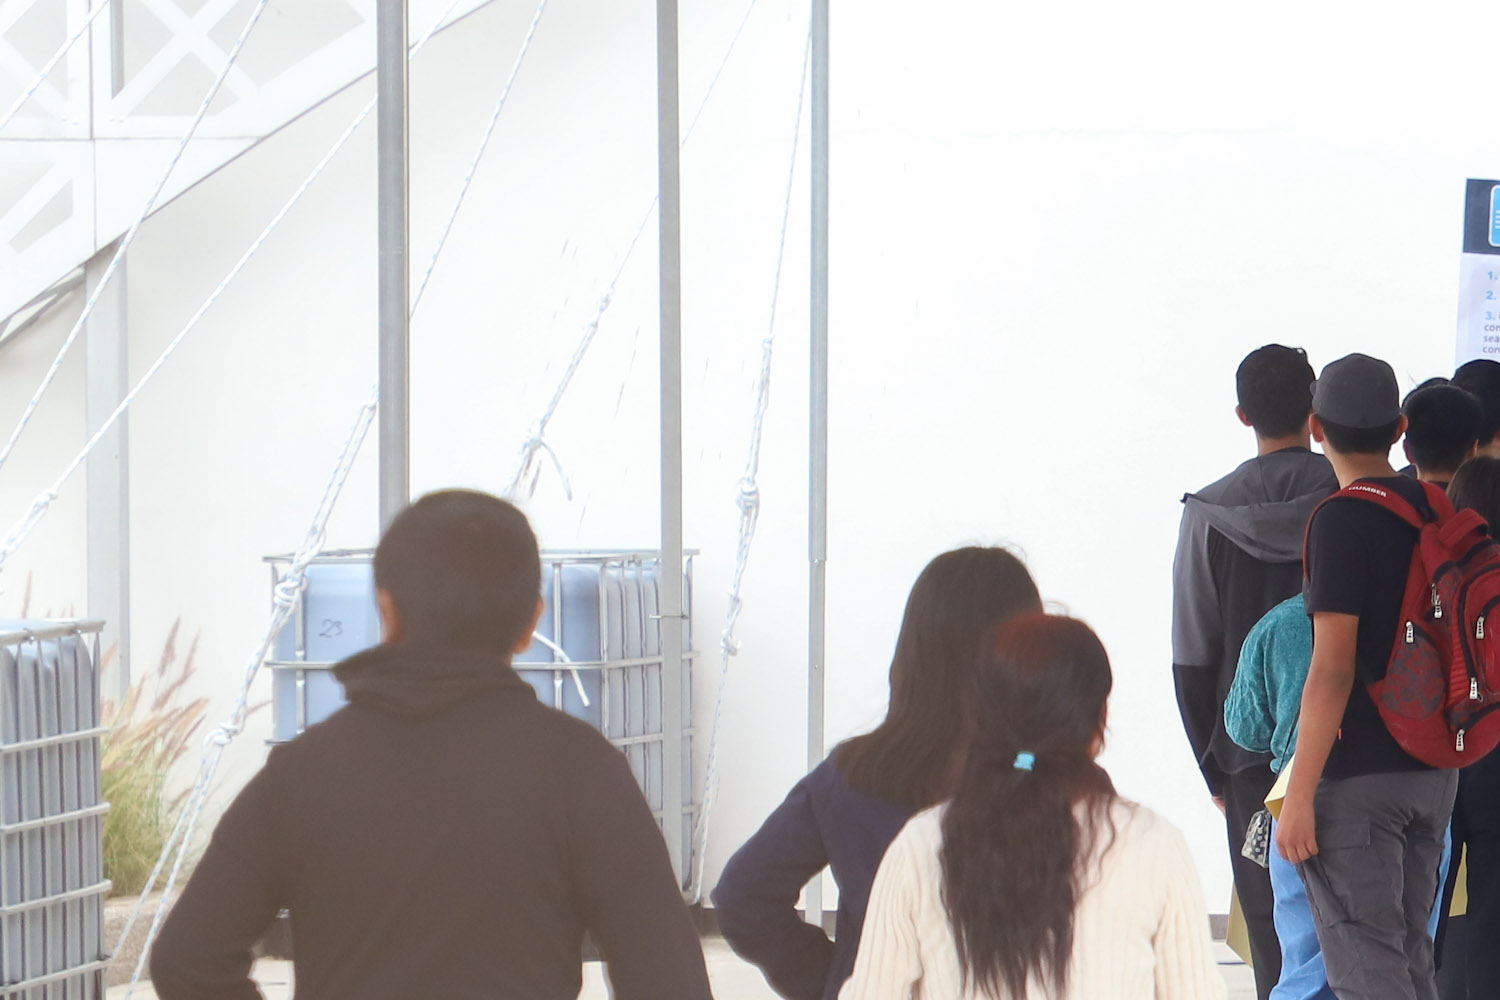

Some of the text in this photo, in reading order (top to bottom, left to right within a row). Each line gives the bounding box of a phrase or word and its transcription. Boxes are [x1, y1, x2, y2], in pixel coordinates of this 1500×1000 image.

[1488, 271, 1498, 280] 1.
[1485, 290, 1497, 300] 2.
[1485, 311, 1496, 321] 3.
[1483, 335, 1500, 343] sea
